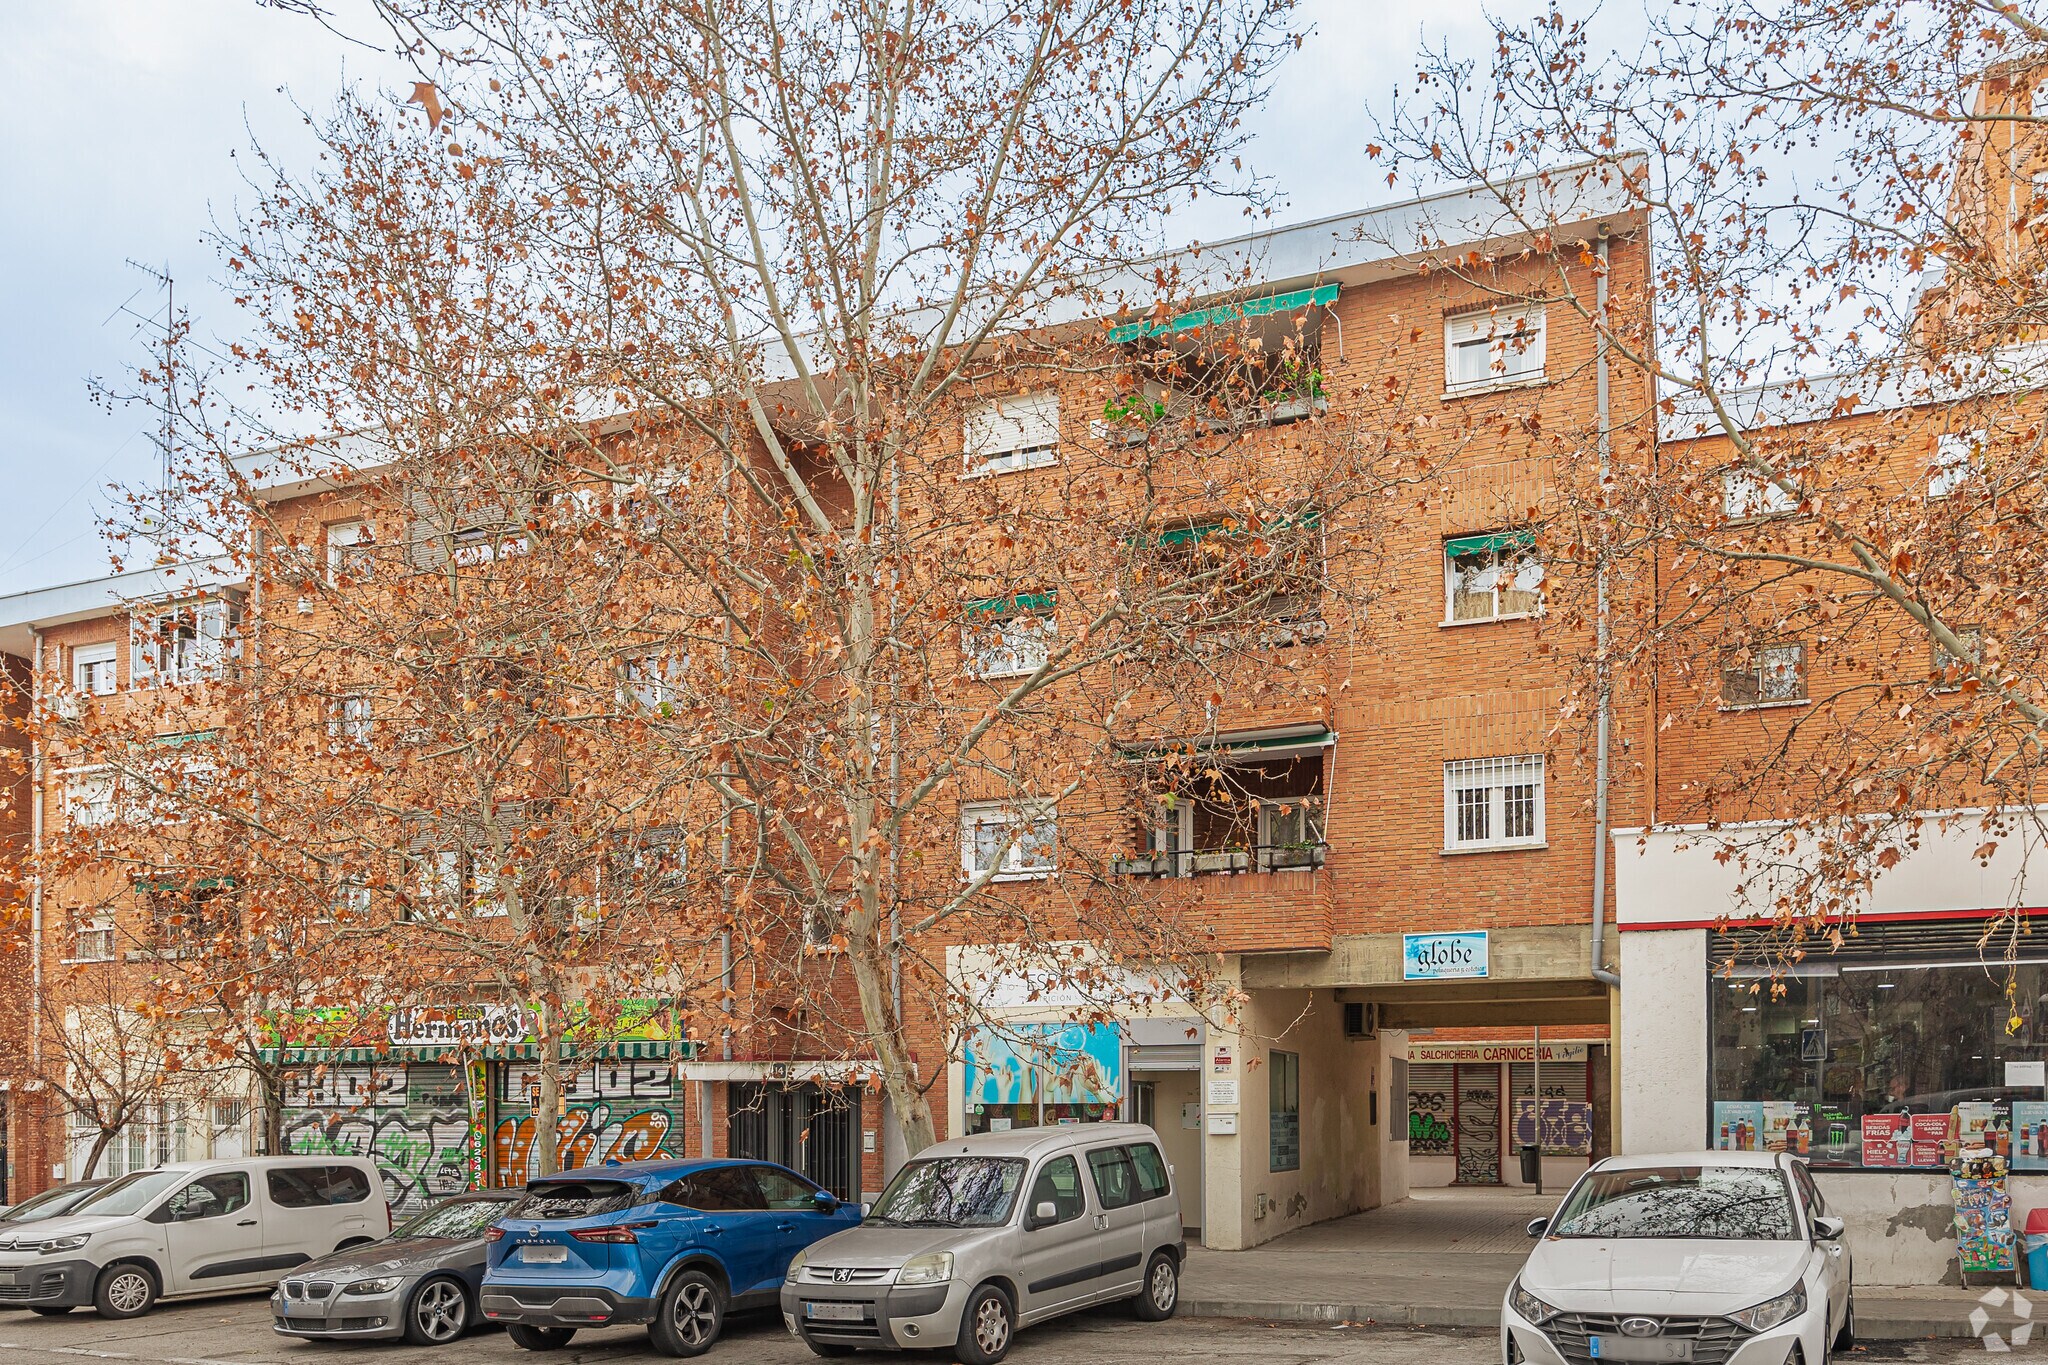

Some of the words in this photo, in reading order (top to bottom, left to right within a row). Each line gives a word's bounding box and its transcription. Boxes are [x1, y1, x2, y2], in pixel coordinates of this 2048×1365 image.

[1418, 939, 1472, 973] globe
[1420, 1050, 1479, 1060] SALCHICHERIA
[1483, 1047, 1553, 1061] CARNICEIA
[775, 1066, 784, 1075] 14
[474, 1141, 482, 1190] 623421
